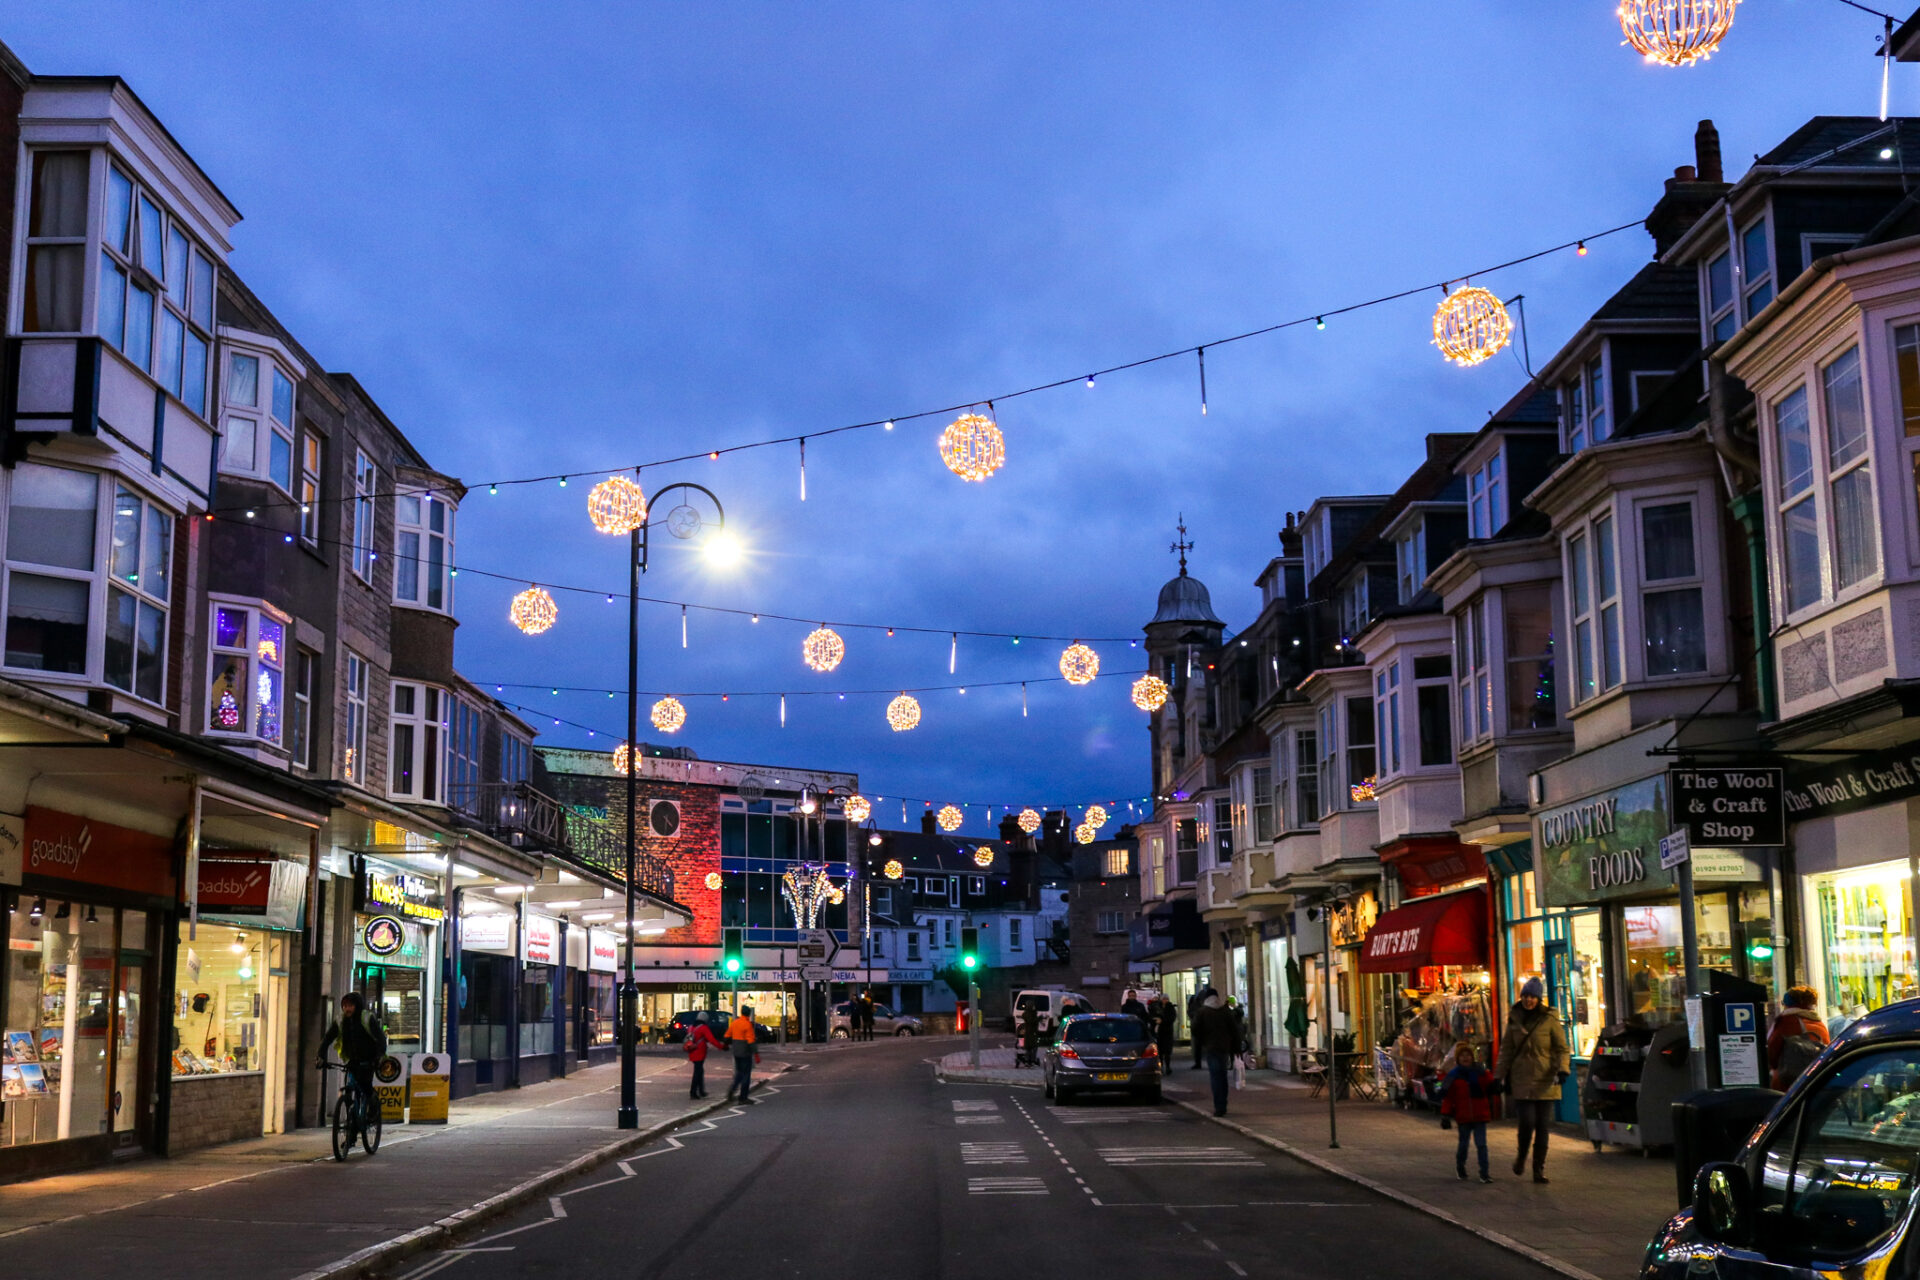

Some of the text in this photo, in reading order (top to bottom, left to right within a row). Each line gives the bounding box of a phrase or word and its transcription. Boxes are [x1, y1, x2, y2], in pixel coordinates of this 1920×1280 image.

[1679, 773, 1774, 789] The Wool
[1784, 790, 1812, 812] The
[1807, 782, 1851, 805] Wool
[1847, 774, 1867, 797] &
[1864, 762, 1914, 792] Craft
[1688, 797, 1767, 813] & Craft
[1543, 798, 1617, 848] COUNTRY
[1702, 822, 1754, 841] Shop
[31, 832, 80, 873] goadsby
[1662, 841, 1668, 857] P
[1590, 848, 1644, 890] FOODS
[1695, 865, 1717, 873] 01929
[1370, 928, 1420, 957] BURT'S BITS
[695, 971, 713, 980] THE
[832, 972, 856, 980] INEMA
[1733, 1008, 1751, 1028] P
